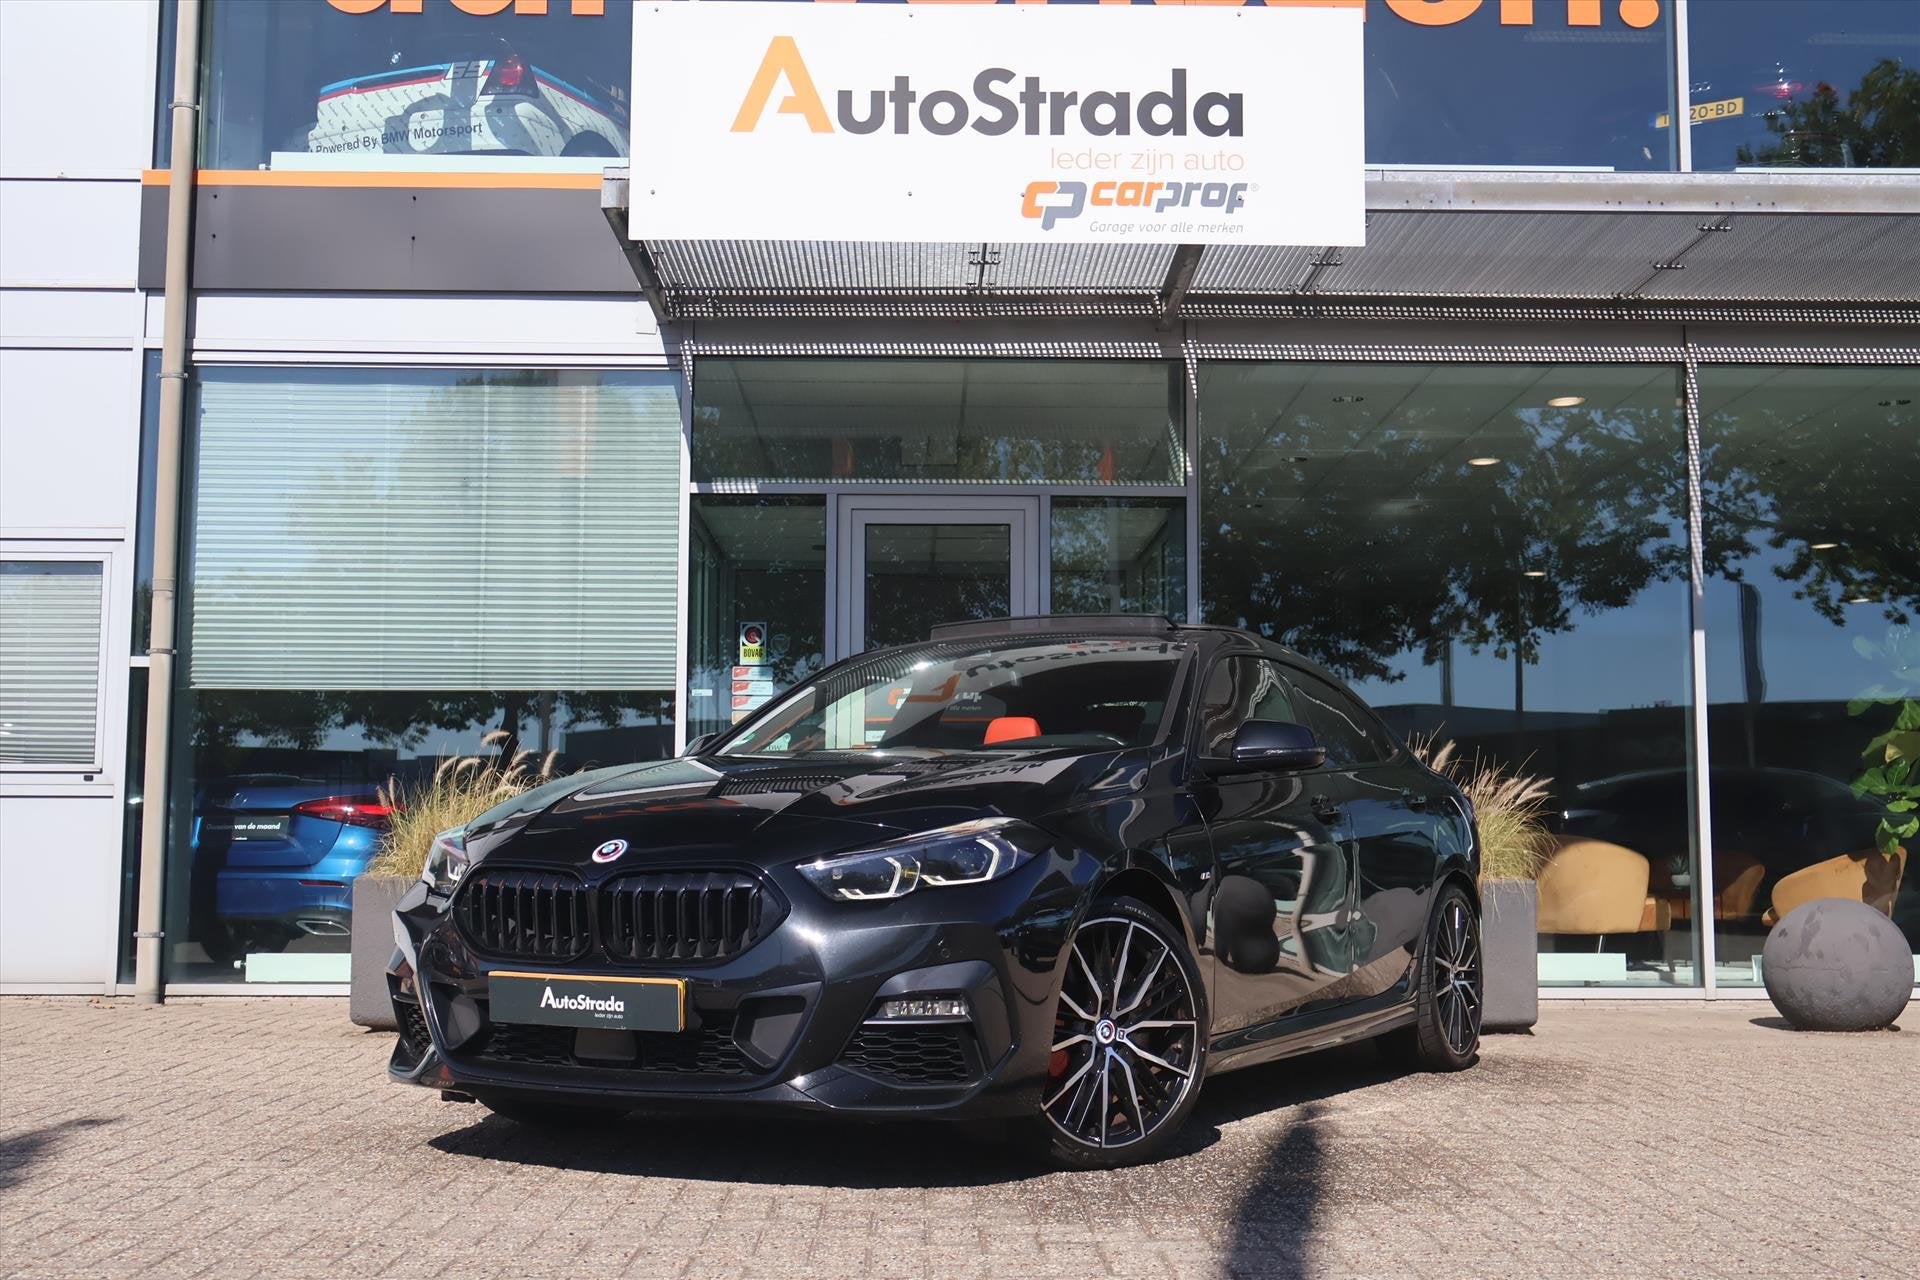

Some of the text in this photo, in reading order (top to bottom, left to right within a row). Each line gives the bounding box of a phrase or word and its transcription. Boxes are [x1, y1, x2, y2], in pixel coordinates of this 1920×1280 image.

[729, 35, 1244, 137] AutoStrada
[315, 122, 483, 153] Powered By BMW Motorsport
[1050, 147, 1246, 176] Ieder zijn auto
[1089, 221, 1244, 235] Garage voor alle merken
[247, 822, 256, 830] de
[540, 986, 624, 1011] AutoStrada
